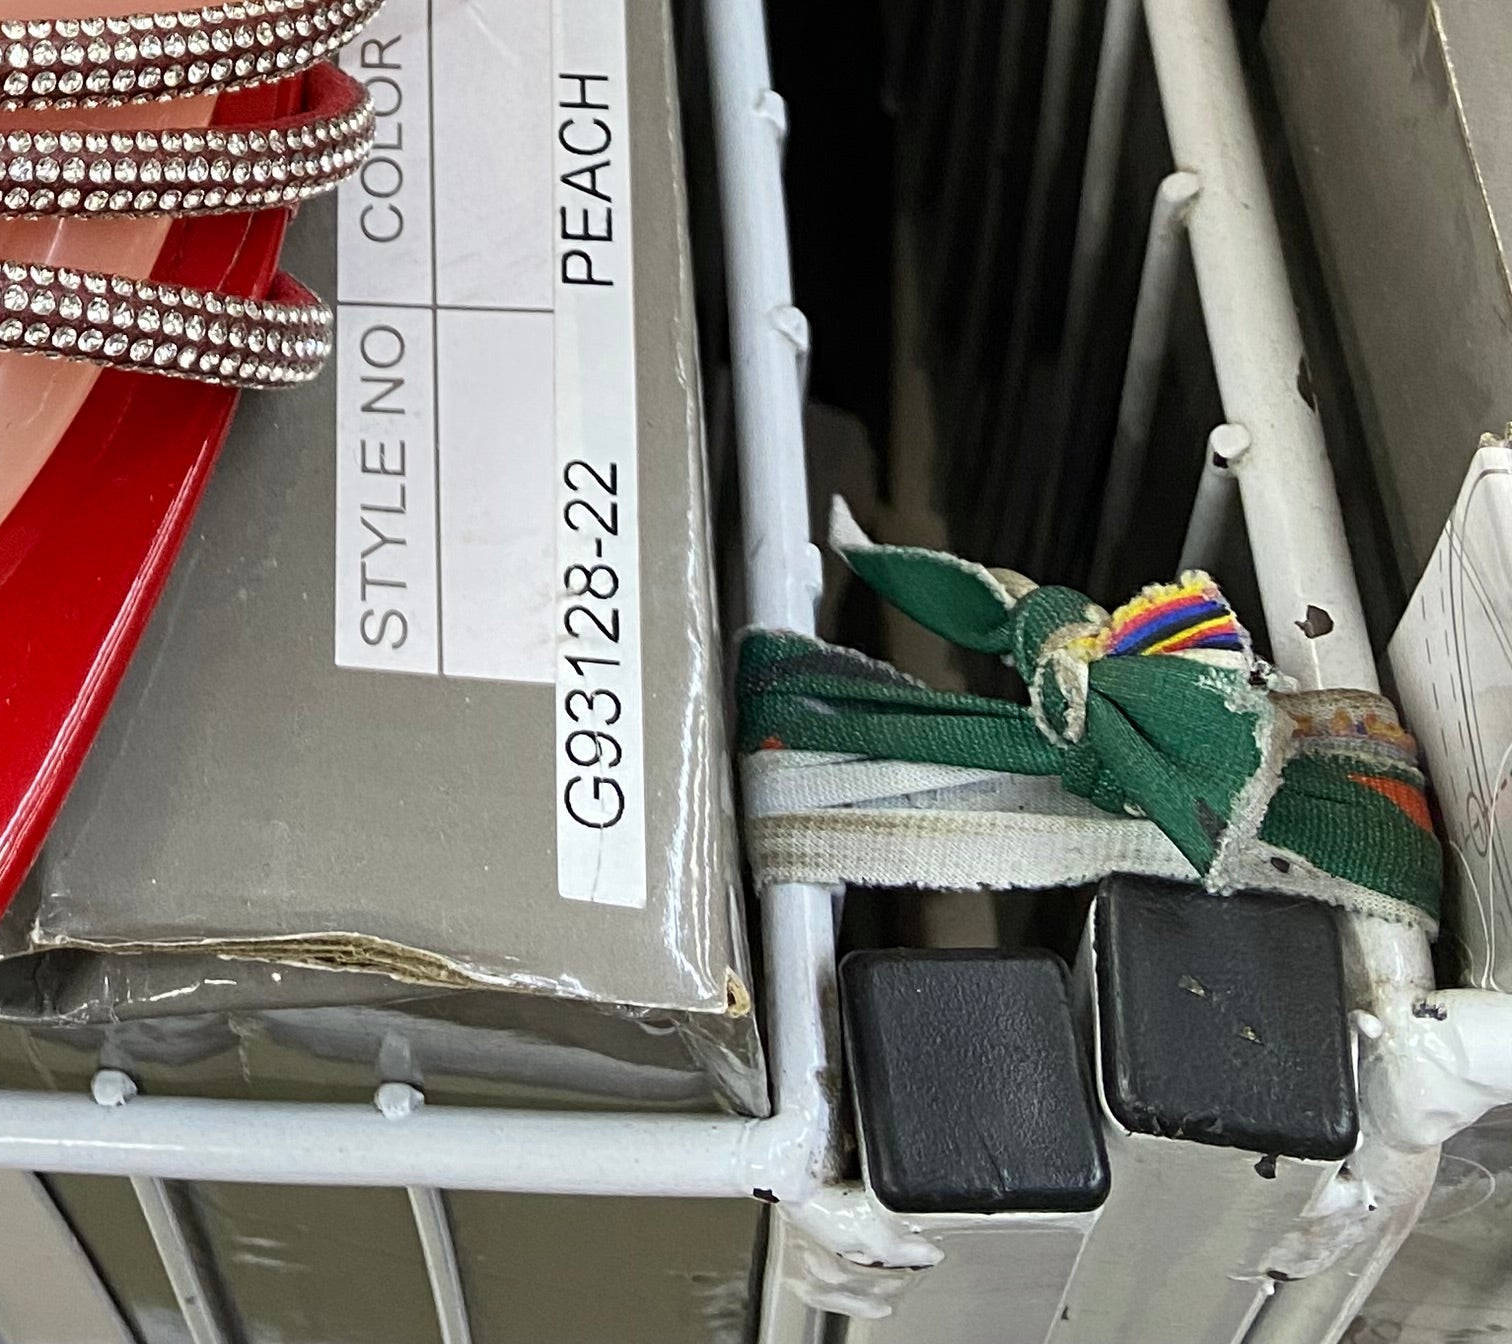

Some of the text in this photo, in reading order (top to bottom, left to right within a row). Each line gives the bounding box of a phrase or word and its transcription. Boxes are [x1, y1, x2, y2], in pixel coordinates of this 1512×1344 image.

[360, 33, 405, 244] COLOR
[559, 73, 615, 288] PEACH
[360, 323, 407, 416] NO
[359, 438, 409, 651] STYLE
[563, 459, 626, 831] G93128-22
